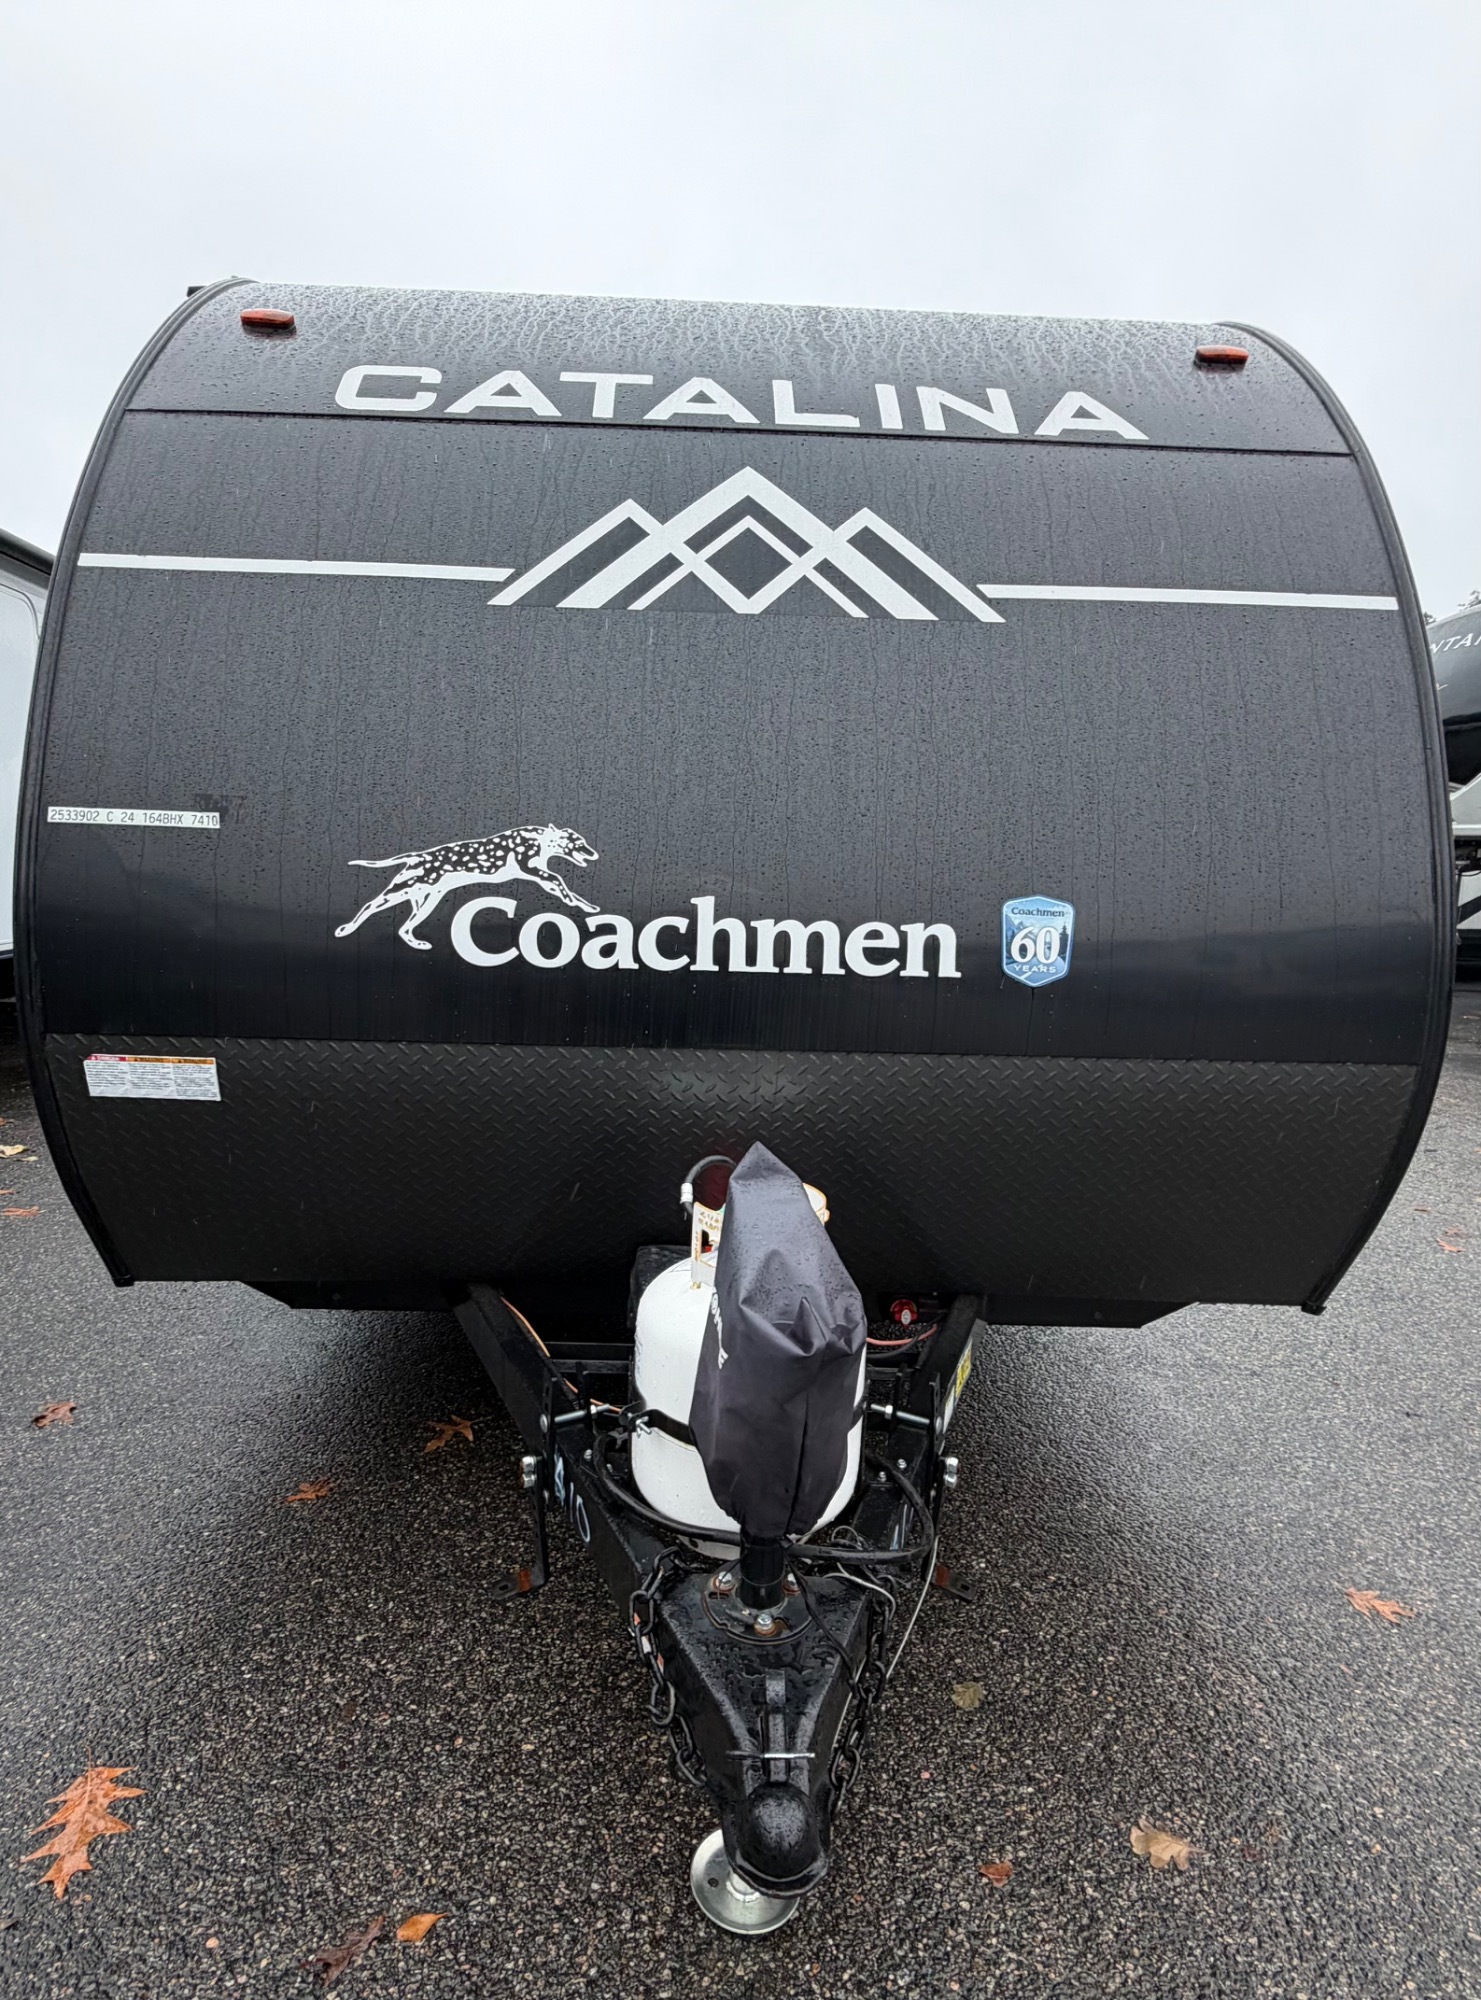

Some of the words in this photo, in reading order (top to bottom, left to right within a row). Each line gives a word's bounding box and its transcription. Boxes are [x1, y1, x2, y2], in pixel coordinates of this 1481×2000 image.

[335, 364, 1150, 440] CATALINA
[50, 809, 100, 822] 2533902
[106, 811, 114, 822] C
[120, 811, 135, 823] 24
[142, 812, 184, 825] 164BHX
[191, 814, 218, 826] 7410
[1011, 906, 1065, 917] Coachmen
[451, 896, 962, 977] Coachmen
[1010, 926, 1060, 964] 60
[1014, 964, 1056, 974] YEARS
